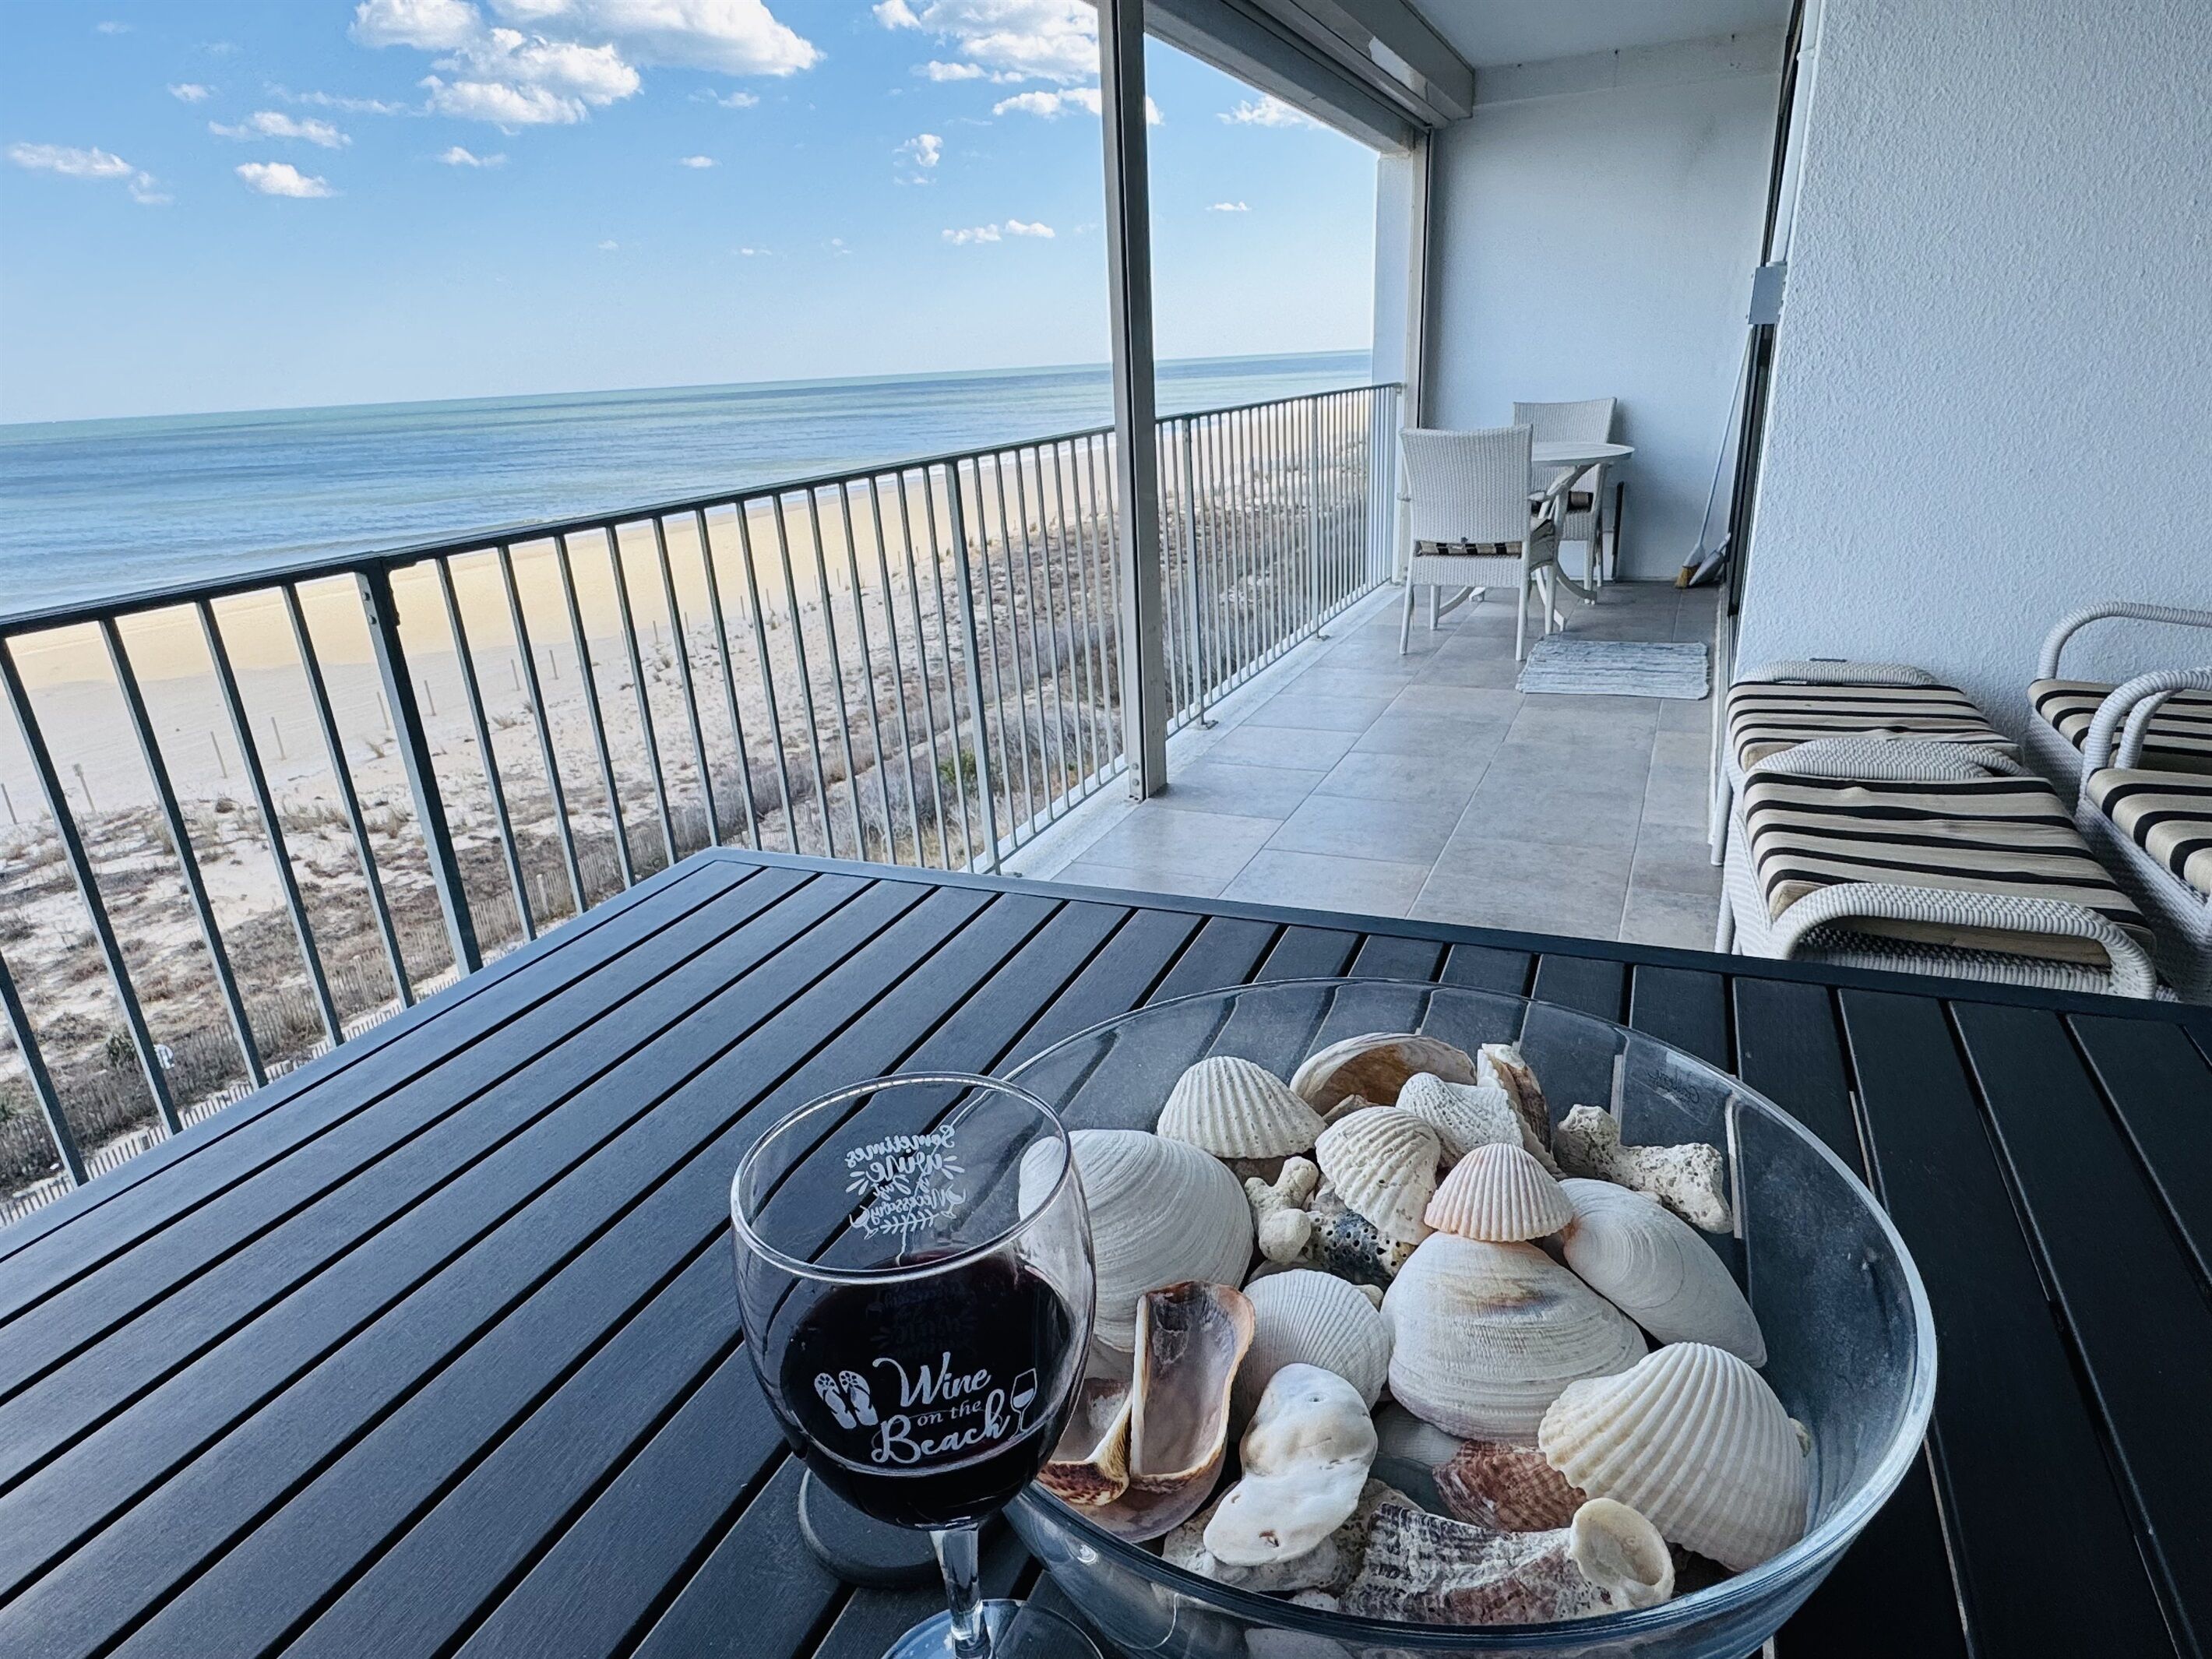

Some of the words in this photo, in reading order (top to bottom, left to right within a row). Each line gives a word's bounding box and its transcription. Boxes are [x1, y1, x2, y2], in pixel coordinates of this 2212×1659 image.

[872, 1351, 991, 1407] Wine
[871, 1388, 1011, 1464] Beach
[917, 1414, 943, 1426] on
[951, 1399, 982, 1420] the
